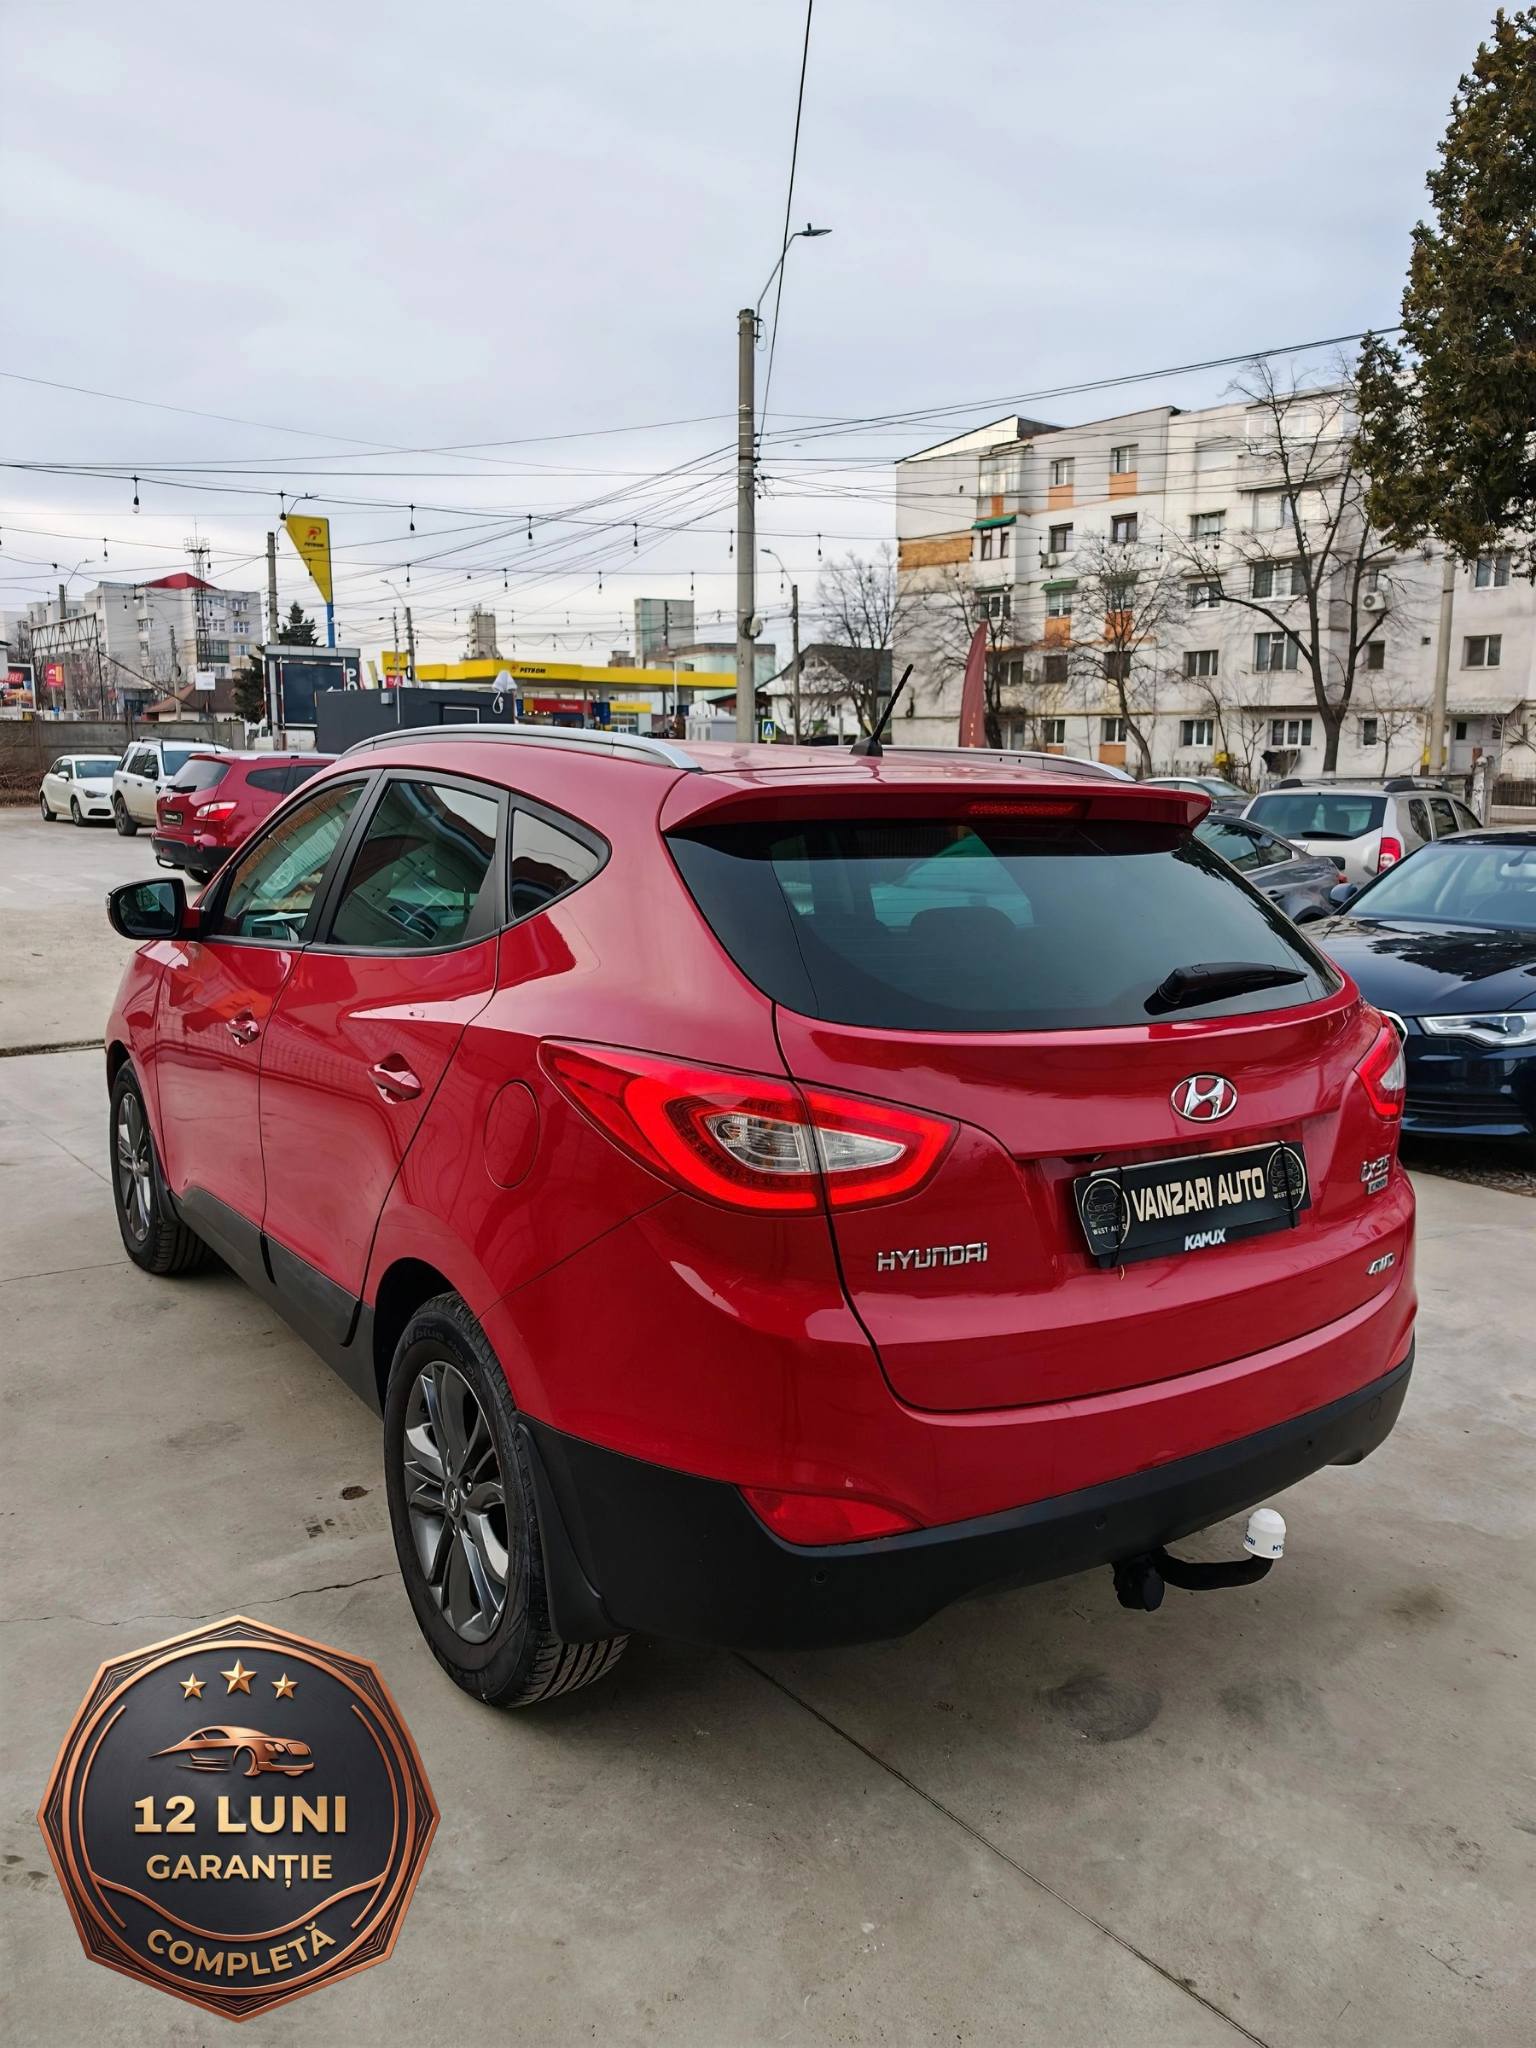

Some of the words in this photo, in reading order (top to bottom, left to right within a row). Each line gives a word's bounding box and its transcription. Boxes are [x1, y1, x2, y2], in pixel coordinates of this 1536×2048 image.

[1360, 1153, 1391, 1182] ix35
[1131, 1176, 1215, 1222] VANZARI
[1218, 1167, 1266, 1207] AUTO
[1184, 1228, 1227, 1251] KAMUX
[877, 1242, 988, 1272] HYUNDAI
